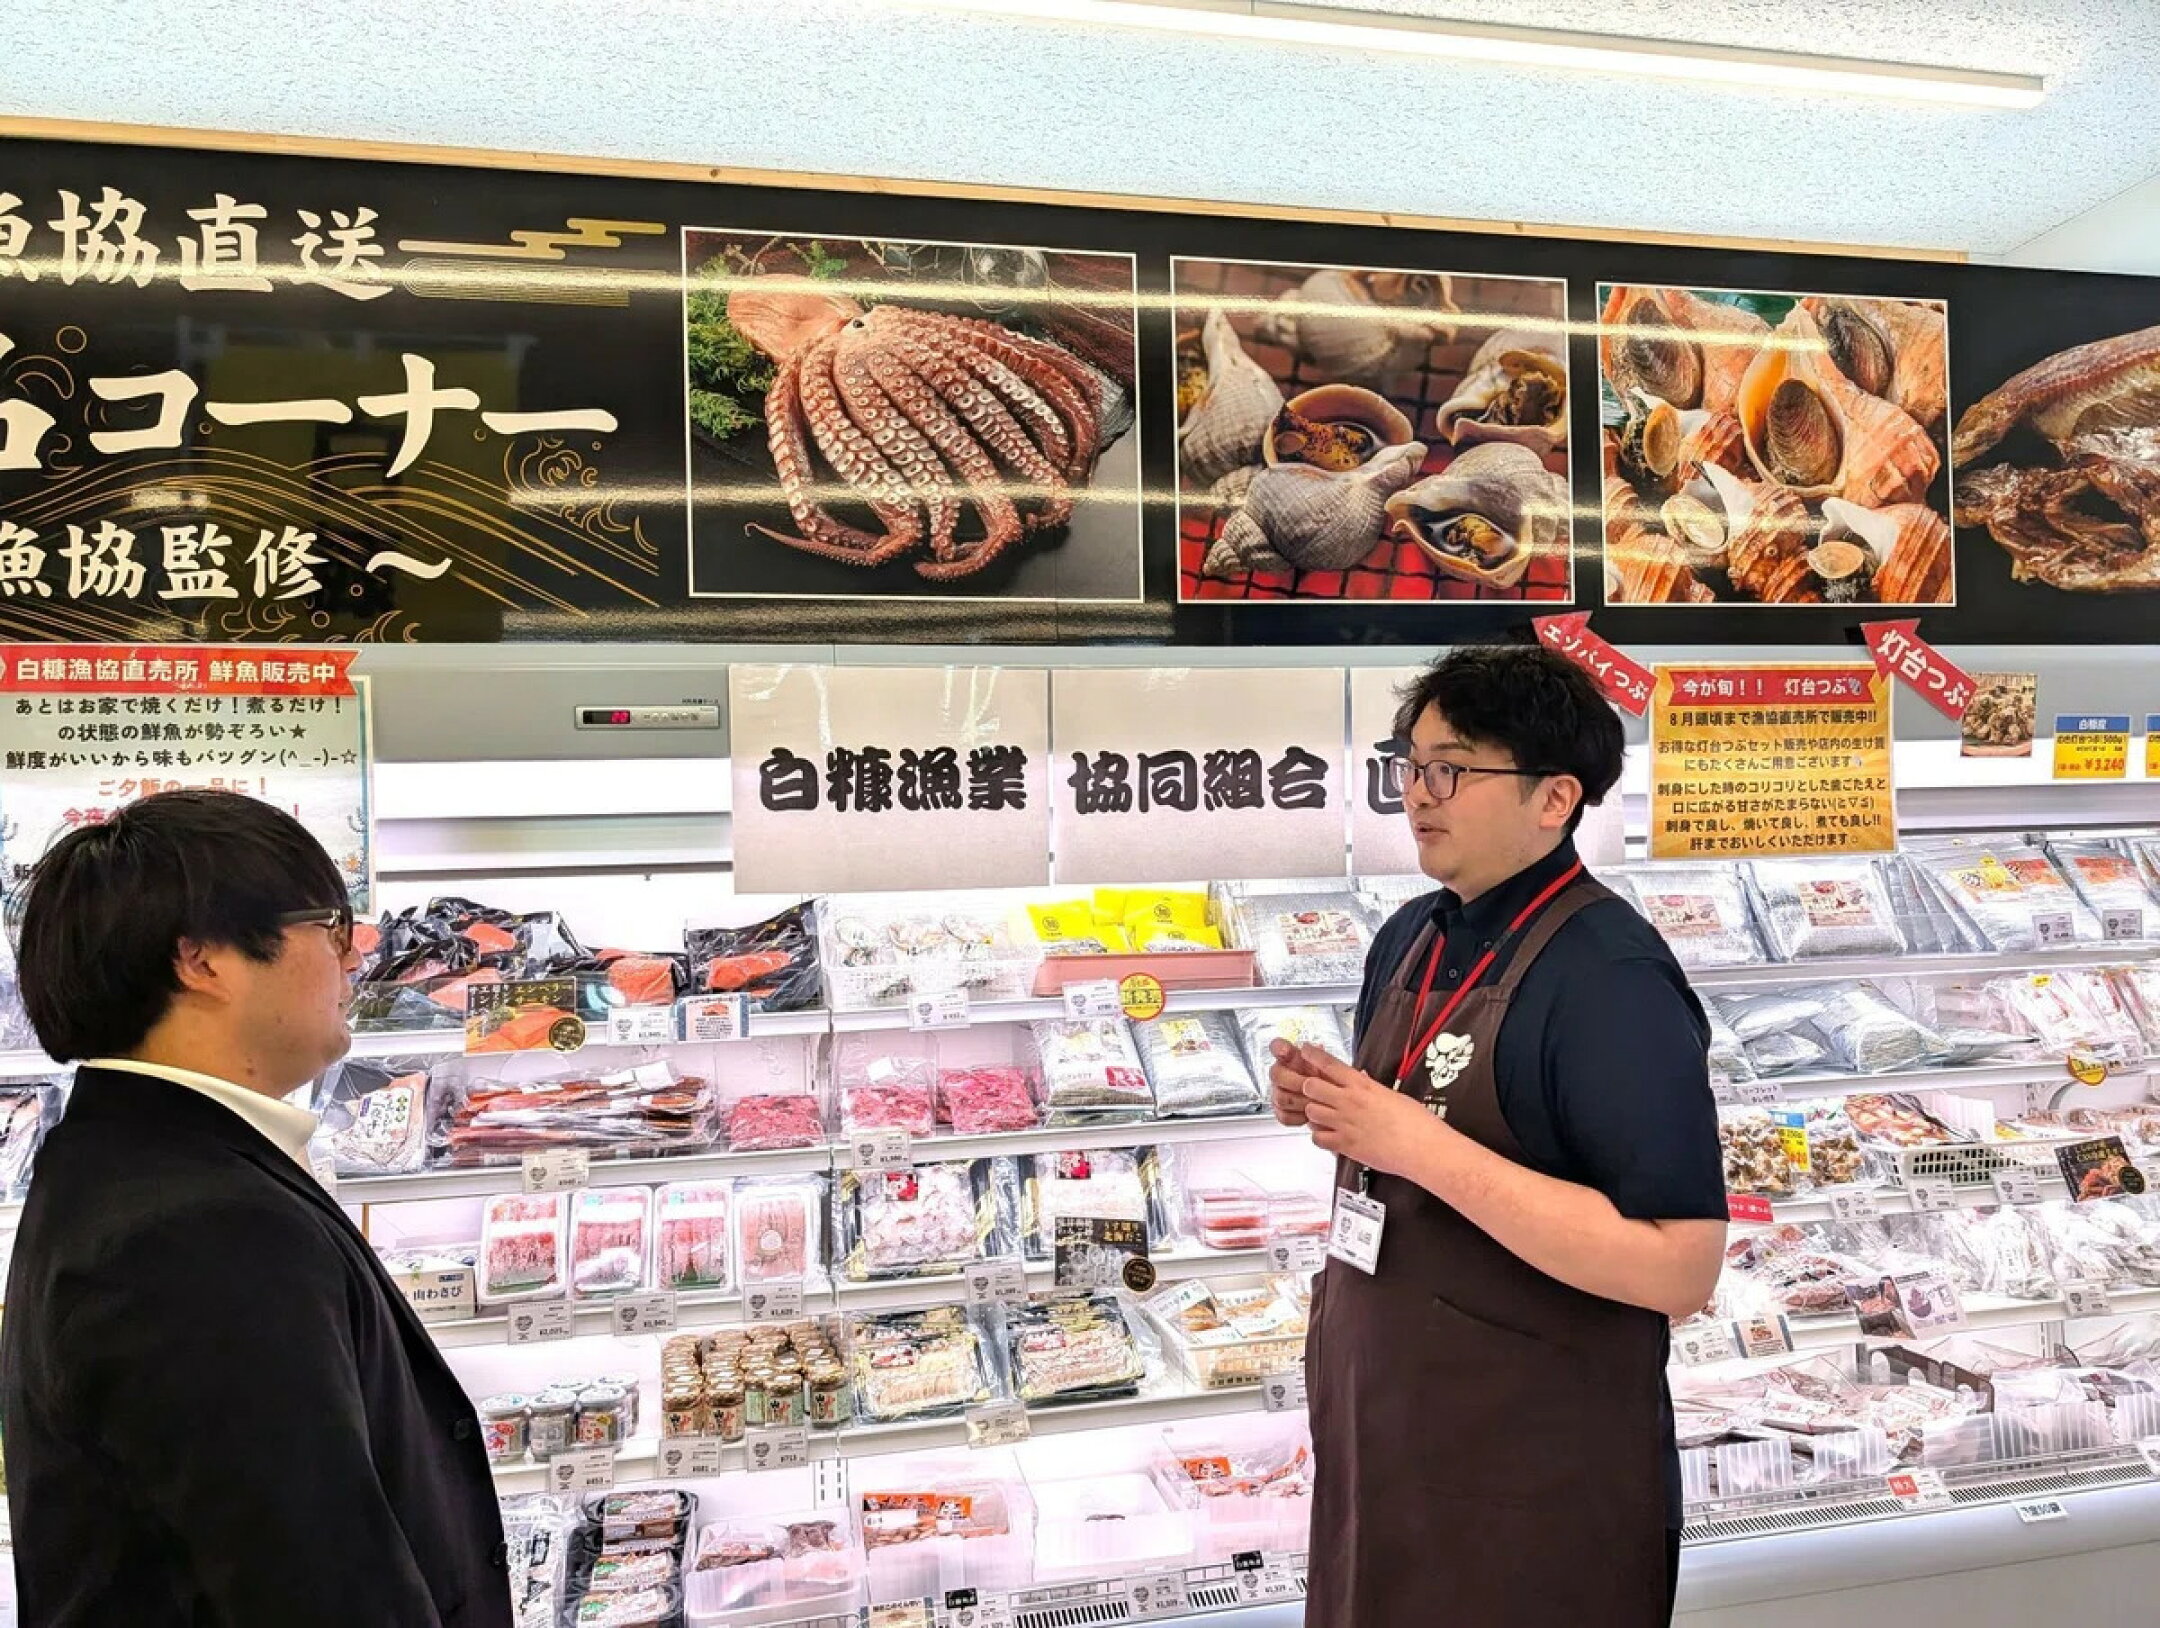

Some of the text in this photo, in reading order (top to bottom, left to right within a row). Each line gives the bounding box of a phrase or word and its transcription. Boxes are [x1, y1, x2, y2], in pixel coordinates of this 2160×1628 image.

[17, 658, 337, 683] 白糠漁協直売所 鮮魚販売中
[1877, 629, 1970, 708] 灯台つぶ
[758, 744, 1028, 812] 白糠漁業
[1067, 746, 1329, 814] 協同組合
